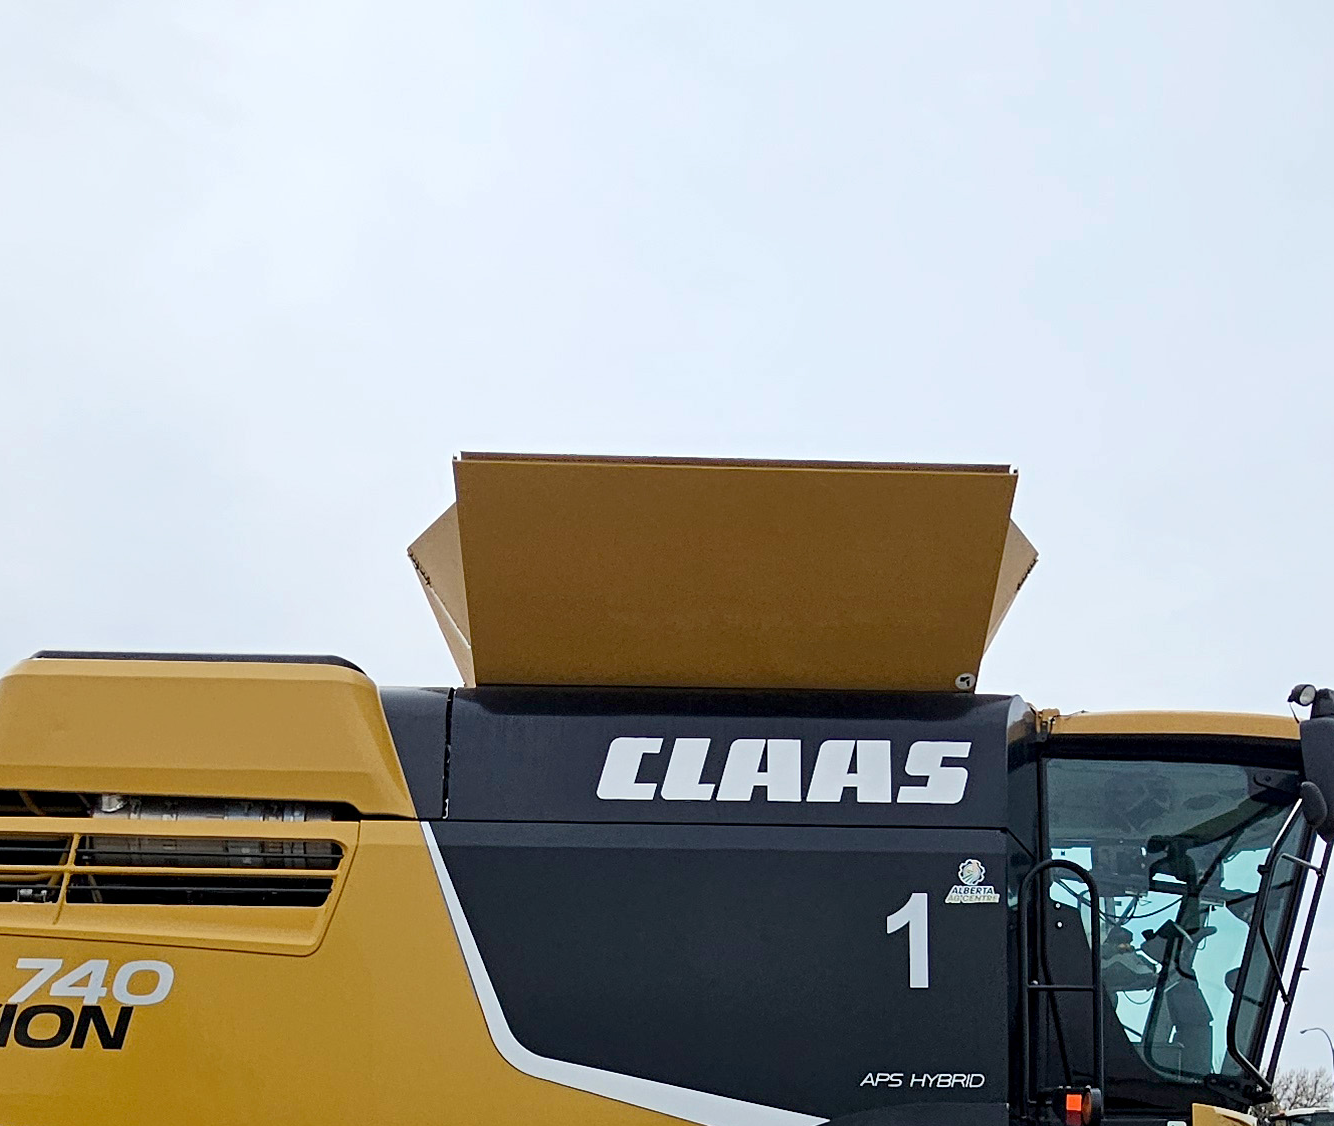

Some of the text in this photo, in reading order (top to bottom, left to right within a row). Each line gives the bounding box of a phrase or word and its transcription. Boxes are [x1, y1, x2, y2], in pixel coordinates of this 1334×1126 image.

[596, 736, 972, 804] CLAAS
[952, 887, 993, 895] ALBERTA
[886, 892, 929, 988] 1
[8, 958, 175, 1006] 740
[859, 1072, 986, 1088] APS HYBRID
